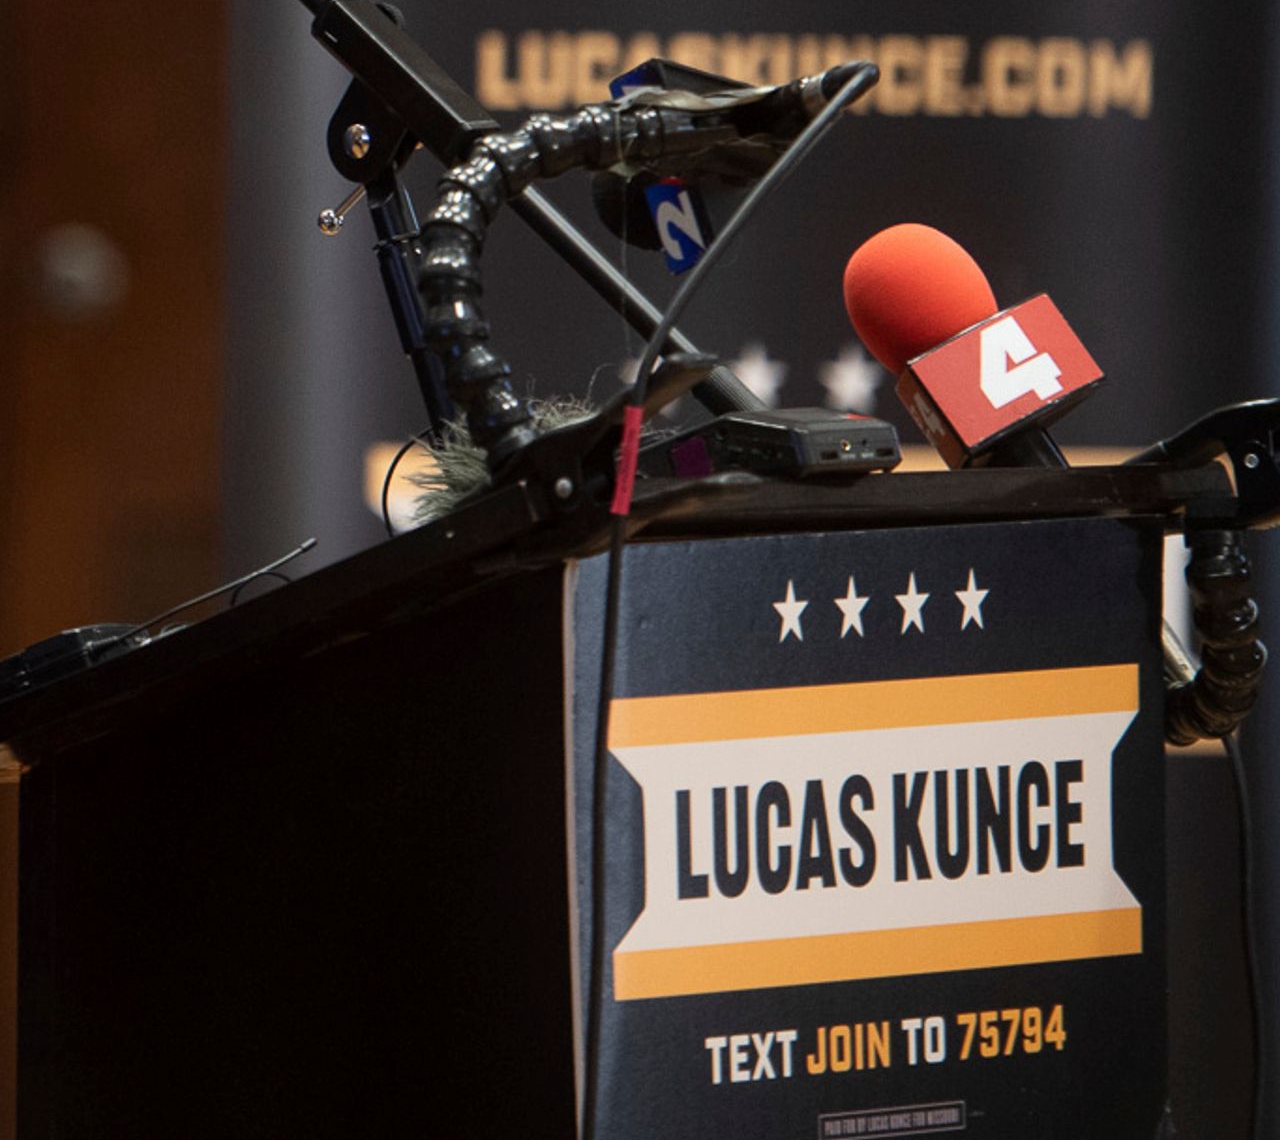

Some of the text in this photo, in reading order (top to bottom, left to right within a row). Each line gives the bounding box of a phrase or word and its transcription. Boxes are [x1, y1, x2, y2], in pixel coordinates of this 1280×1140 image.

[656, 190, 706, 260] 2
[979, 316, 1063, 410] 4
[675, 759, 1085, 900] LUCAS KUNCE
[705, 1004, 1066, 1085] TEXT JOIN TO 75794
